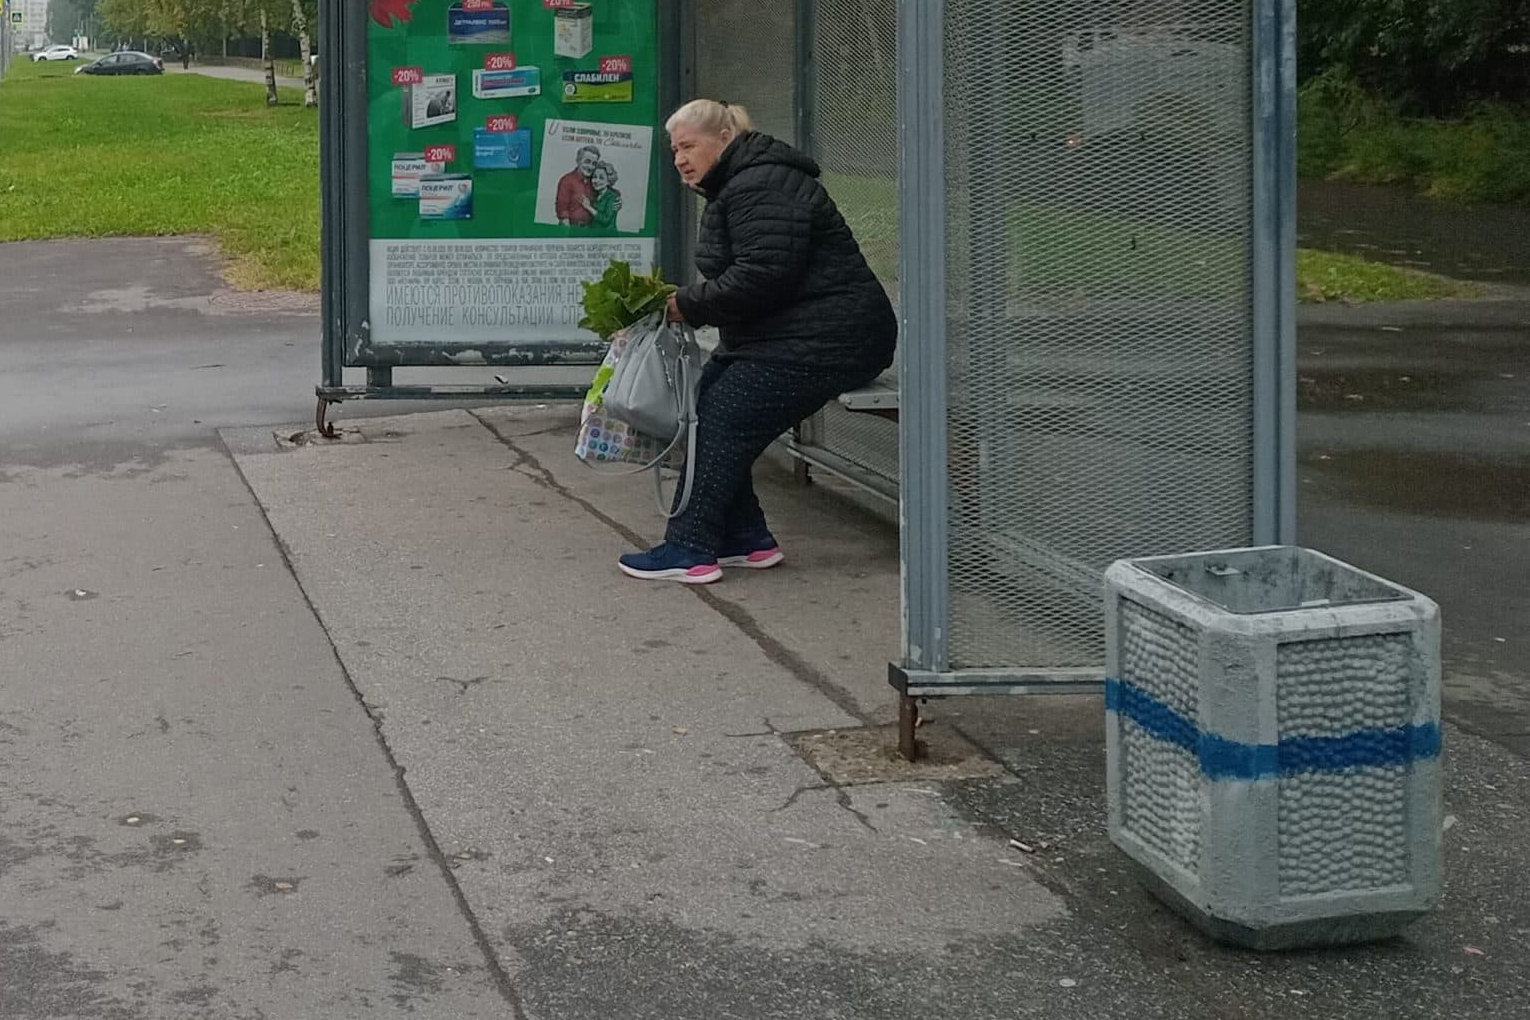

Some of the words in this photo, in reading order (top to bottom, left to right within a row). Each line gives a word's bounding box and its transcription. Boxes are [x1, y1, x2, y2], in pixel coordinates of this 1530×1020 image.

[487, 57, 512, 69] -20%
[602, 59, 627, 71] -20%
[394, 70, 419, 82] -20%
[574, 73, 620, 82] СЛАБИЛЕН
[488, 119, 514, 131] -20%
[427, 148, 452, 160] -20%
[386, 285, 441, 306] ИМЕЮТСЯ
[386, 306, 454, 326] ПОЛУЧЕНИЕ
[462, 306, 554, 327] КОНСУЛЬТАЦИИ
